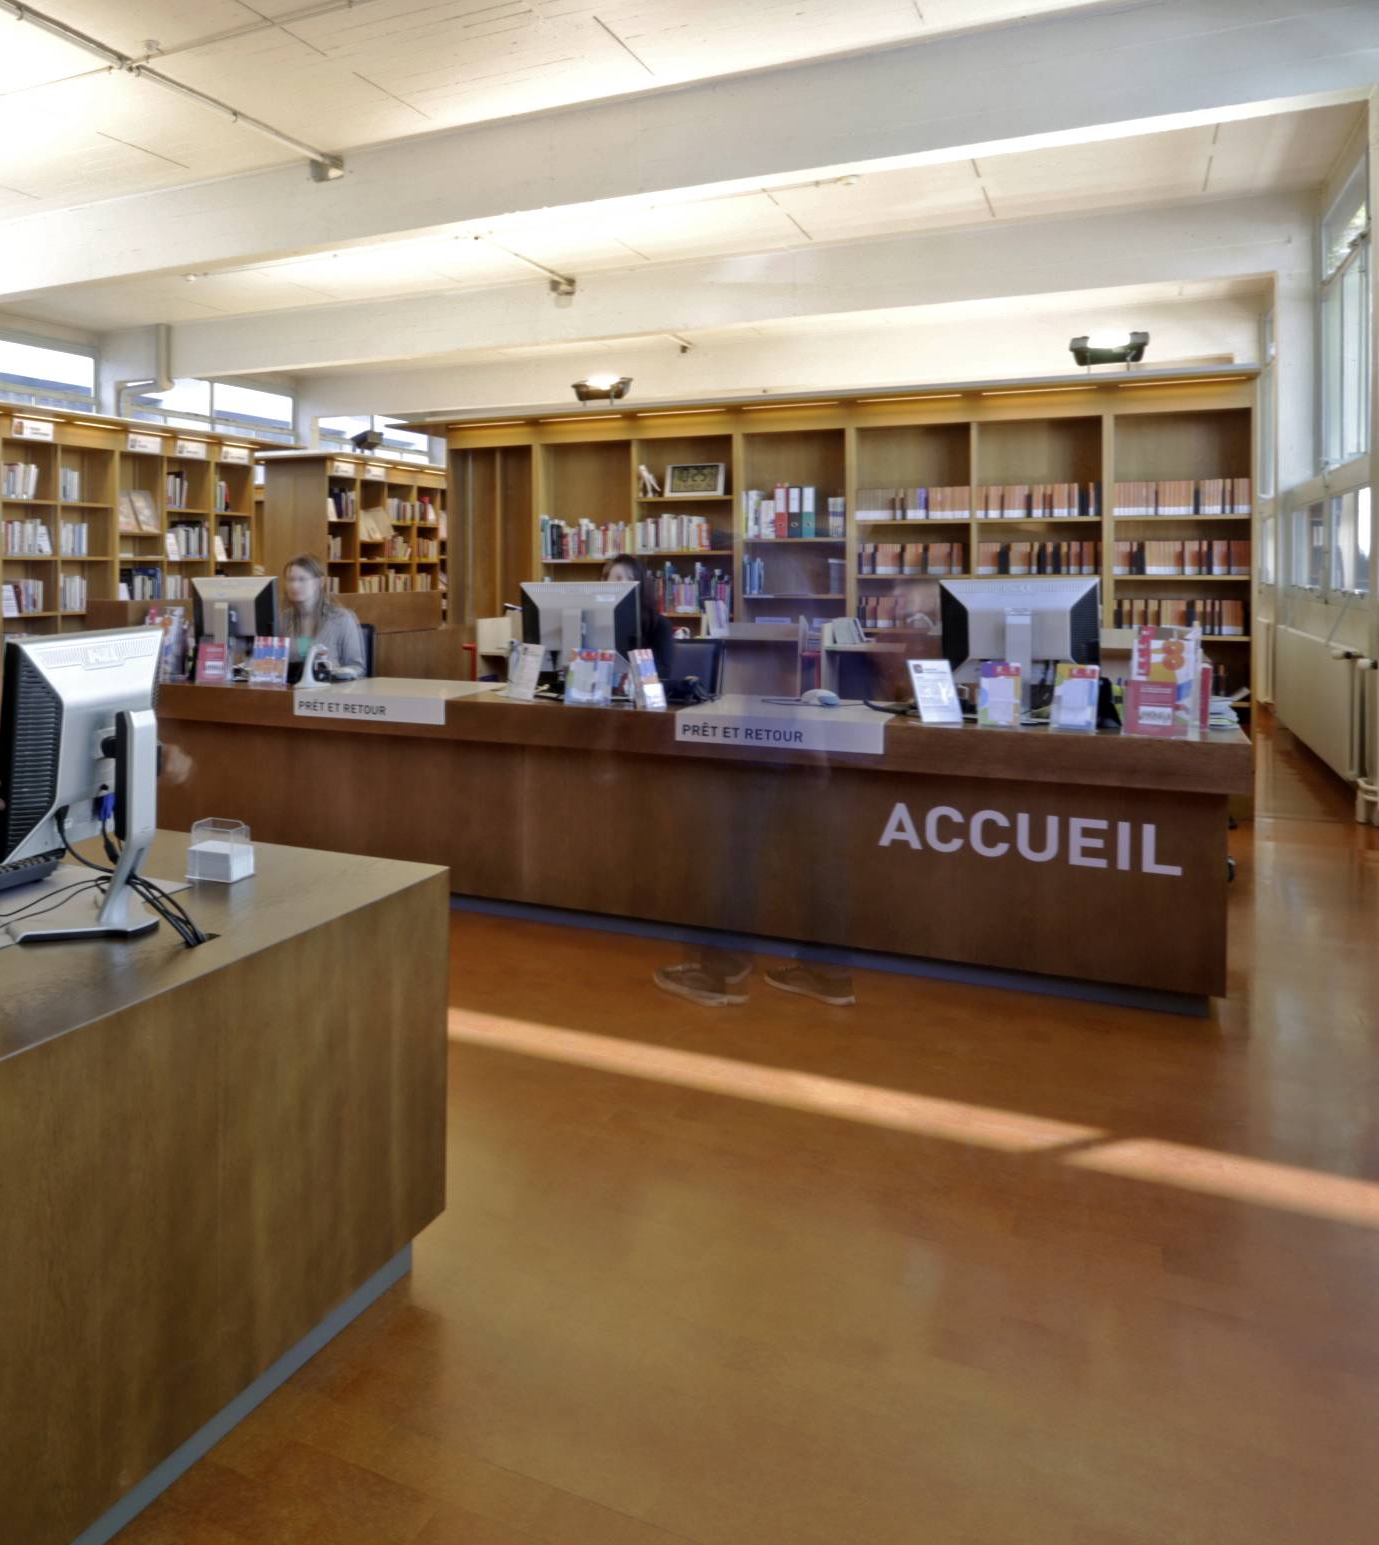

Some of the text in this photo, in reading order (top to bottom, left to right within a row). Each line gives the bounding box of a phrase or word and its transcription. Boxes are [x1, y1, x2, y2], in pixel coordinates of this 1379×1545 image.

[328, 702, 340, 713] ET
[343, 704, 387, 716] RETOUR
[682, 722, 803, 743] PRÊT ET RETOUR
[878, 802, 1183, 876] ACCUEIL
